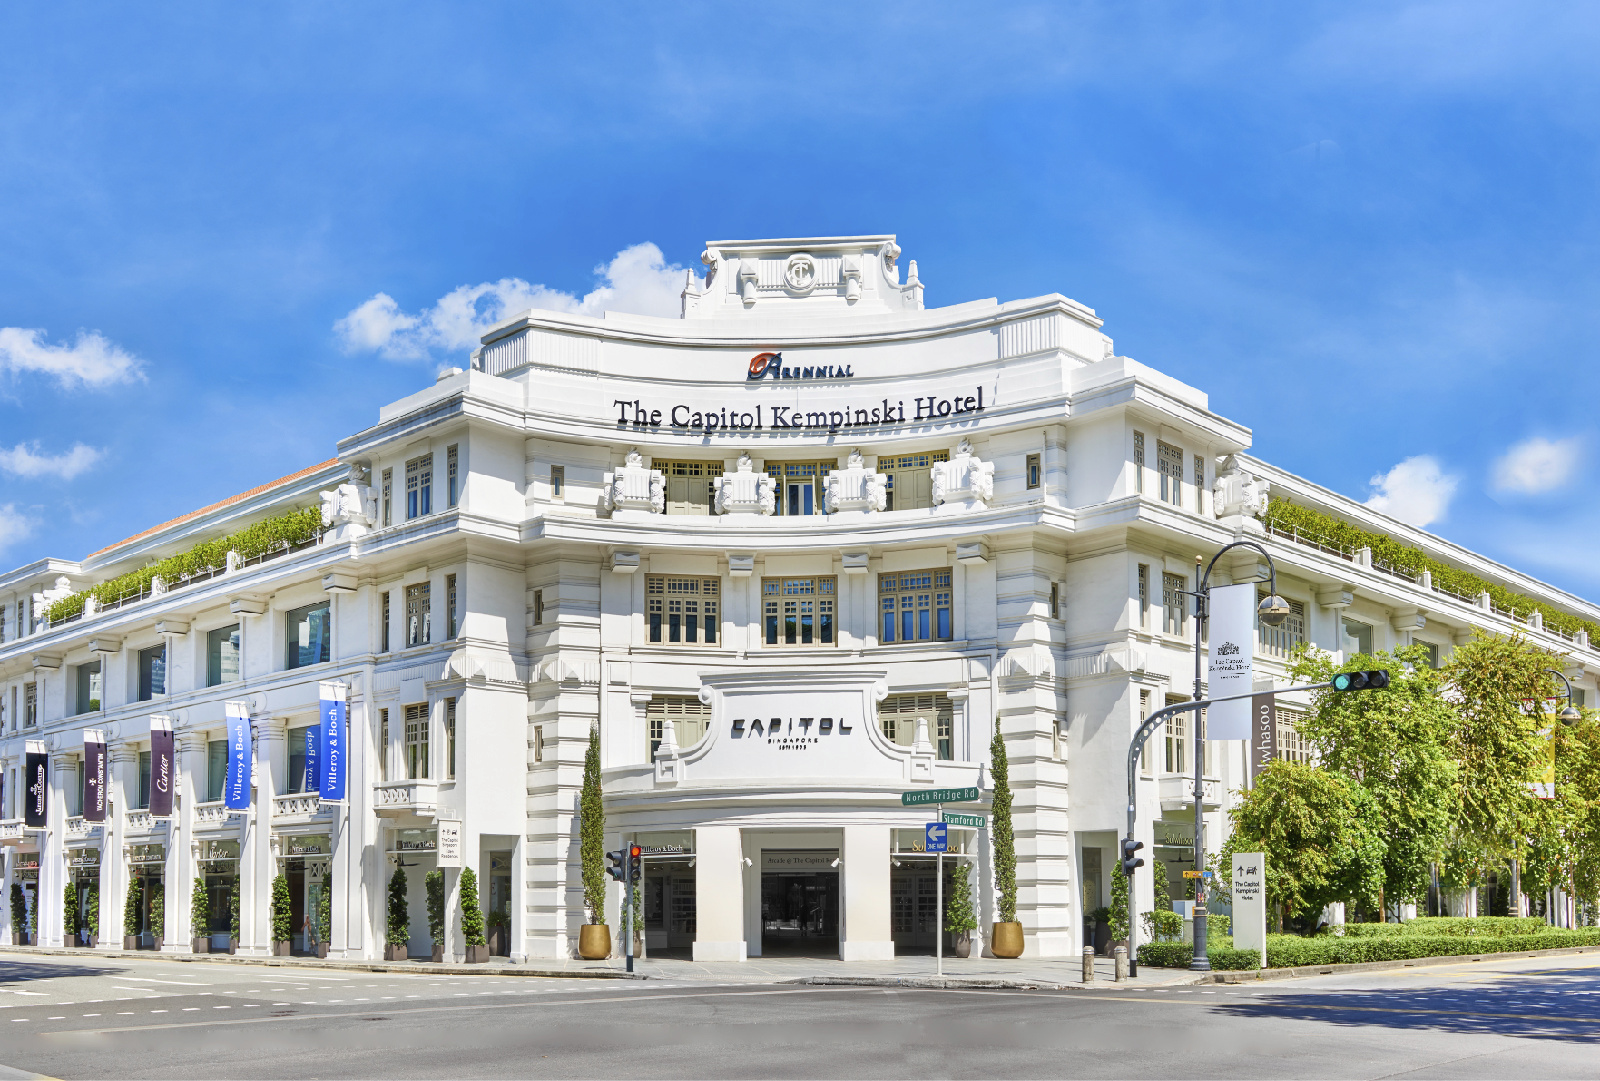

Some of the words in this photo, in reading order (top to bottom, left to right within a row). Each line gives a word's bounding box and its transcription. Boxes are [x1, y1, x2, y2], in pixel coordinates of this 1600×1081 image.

[613, 400, 662, 426] The
[671, 404, 763, 434] Capitol
[770, 398, 906, 434] Kempinski
[913, 386, 985, 419] Hotel
[329, 709, 338, 737] Boch
[732, 717, 853, 731] CAPITOL
[235, 725, 243, 751] Boch
[330, 738, 337, 747] &
[237, 752, 243, 760] &
[157, 754, 169, 792] Cartier
[233, 761, 245, 801] Villeroy
[328, 748, 339, 791] Villeroy
[906, 792, 930, 802] North
[933, 790, 961, 800] Bridge
[964, 788, 975, 799] Rd
[944, 814, 973, 826] Stanford
[975, 818, 983, 827] Rd
